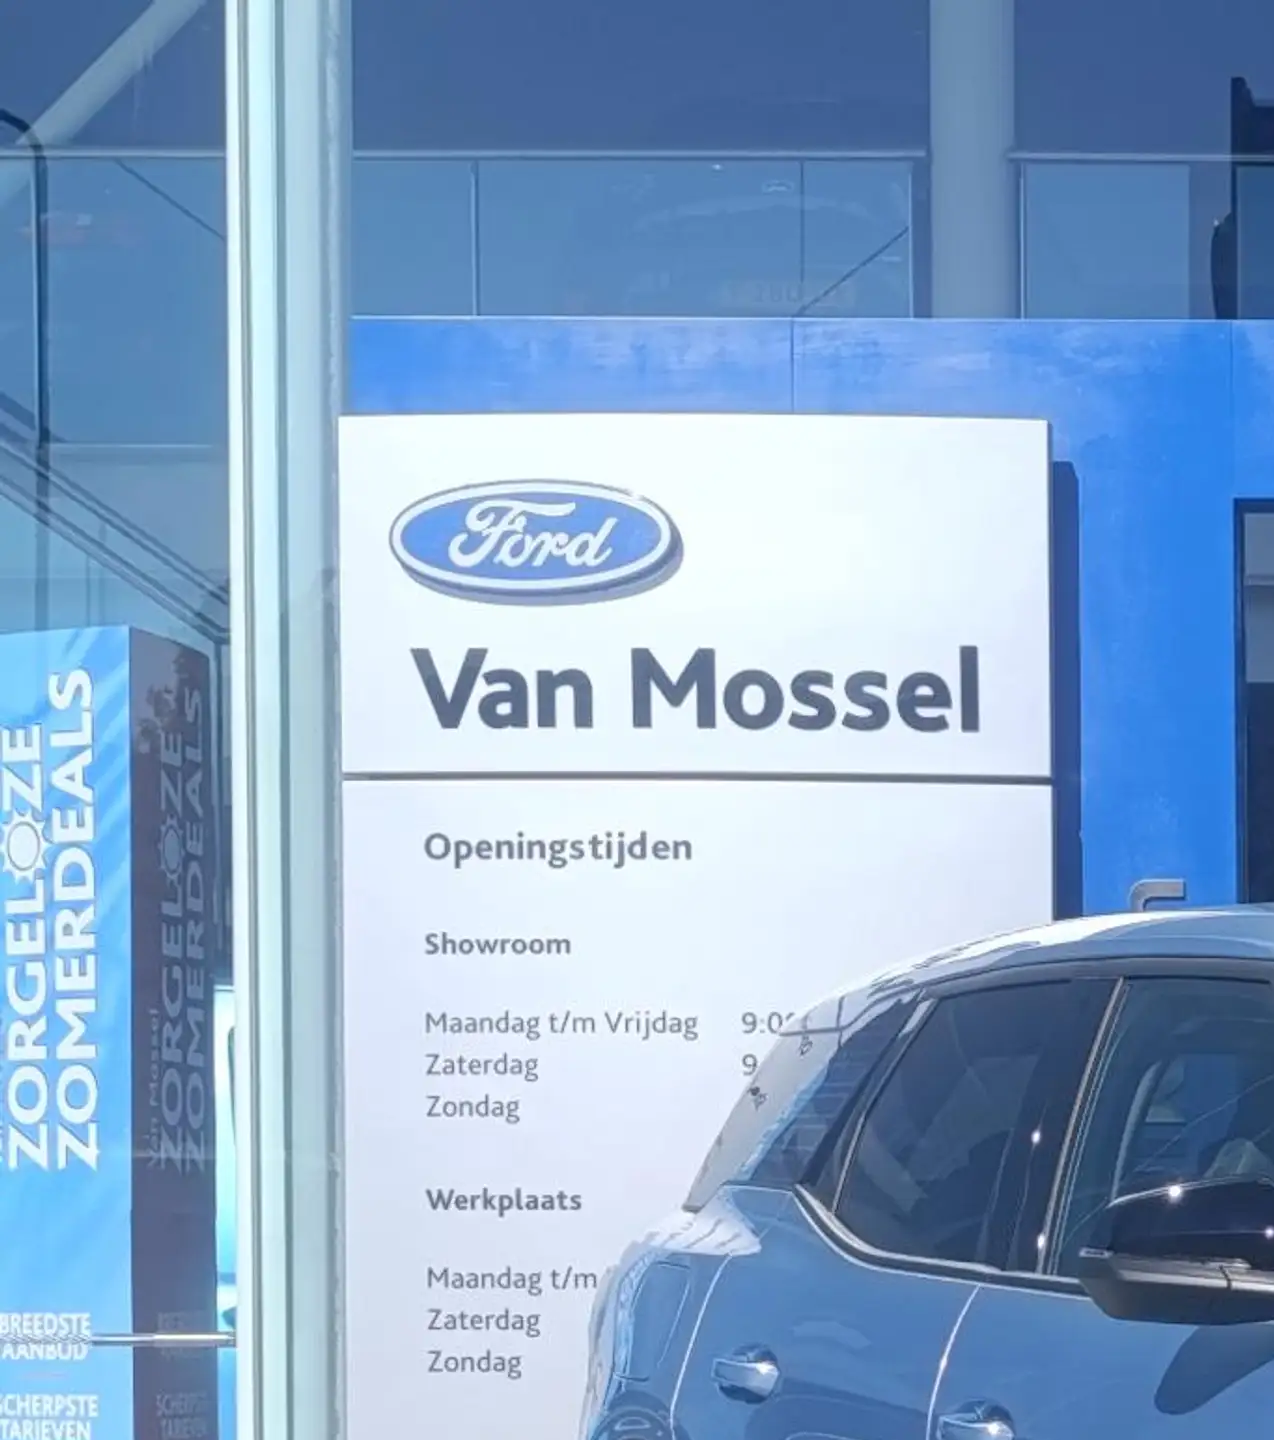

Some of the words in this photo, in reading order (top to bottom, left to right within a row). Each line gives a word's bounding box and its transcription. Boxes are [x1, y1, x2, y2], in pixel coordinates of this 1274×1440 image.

[447, 499, 619, 568] Ford
[410, 647, 594, 730] Van
[630, 645, 980, 733] Mossel
[423, 831, 693, 868] Openingstijden
[49, 668, 98, 1172] ZOMERDEALS
[424, 932, 572, 955] Showroom
[425, 1011, 541, 1041] Maandag
[549, 1011, 596, 1035] t/m
[604, 1011, 699, 1041] Vrijdag
[741, 1011, 795, 1034] 9:0
[425, 1053, 539, 1082] Zaterdag
[742, 1053, 758, 1076] 9
[426, 1095, 521, 1124] Zondag
[426, 1188, 582, 1217] Werkplaats
[427, 1266, 542, 1295] Maandag
[550, 1266, 597, 1289] t/m
[427, 1309, 541, 1338] Zaterdag
[427, 1350, 522, 1379] Zondag
